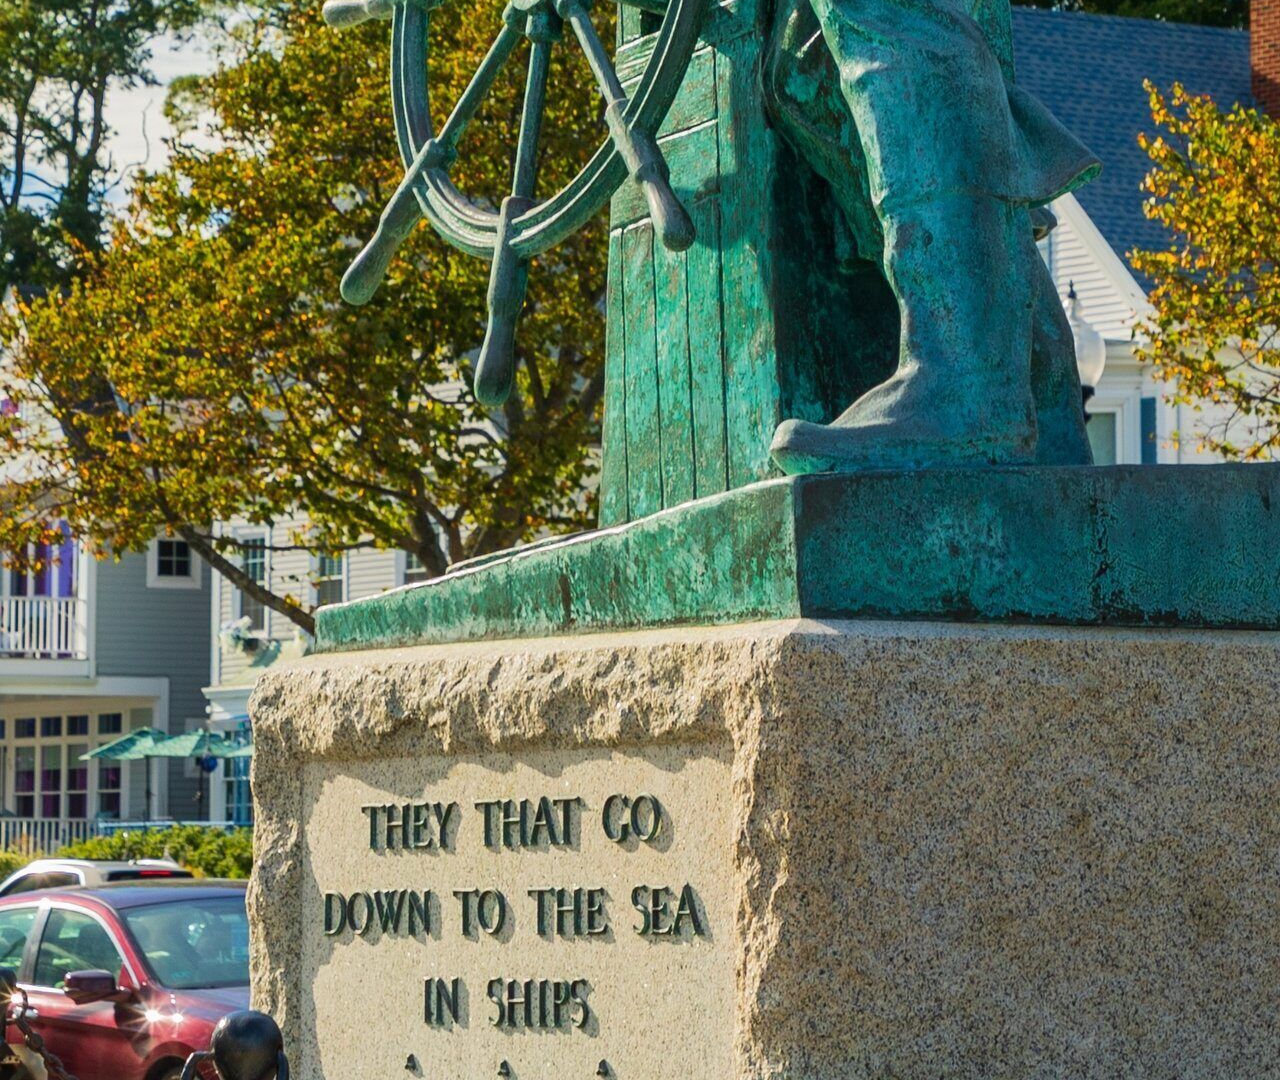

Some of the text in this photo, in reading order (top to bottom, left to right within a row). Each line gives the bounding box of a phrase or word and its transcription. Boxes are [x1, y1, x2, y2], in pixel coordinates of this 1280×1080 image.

[361, 792, 661, 850] THEY THAT GO
[324, 882, 705, 936] DOWN TO THE SEA
[424, 976, 590, 1028] IN SHIPS
